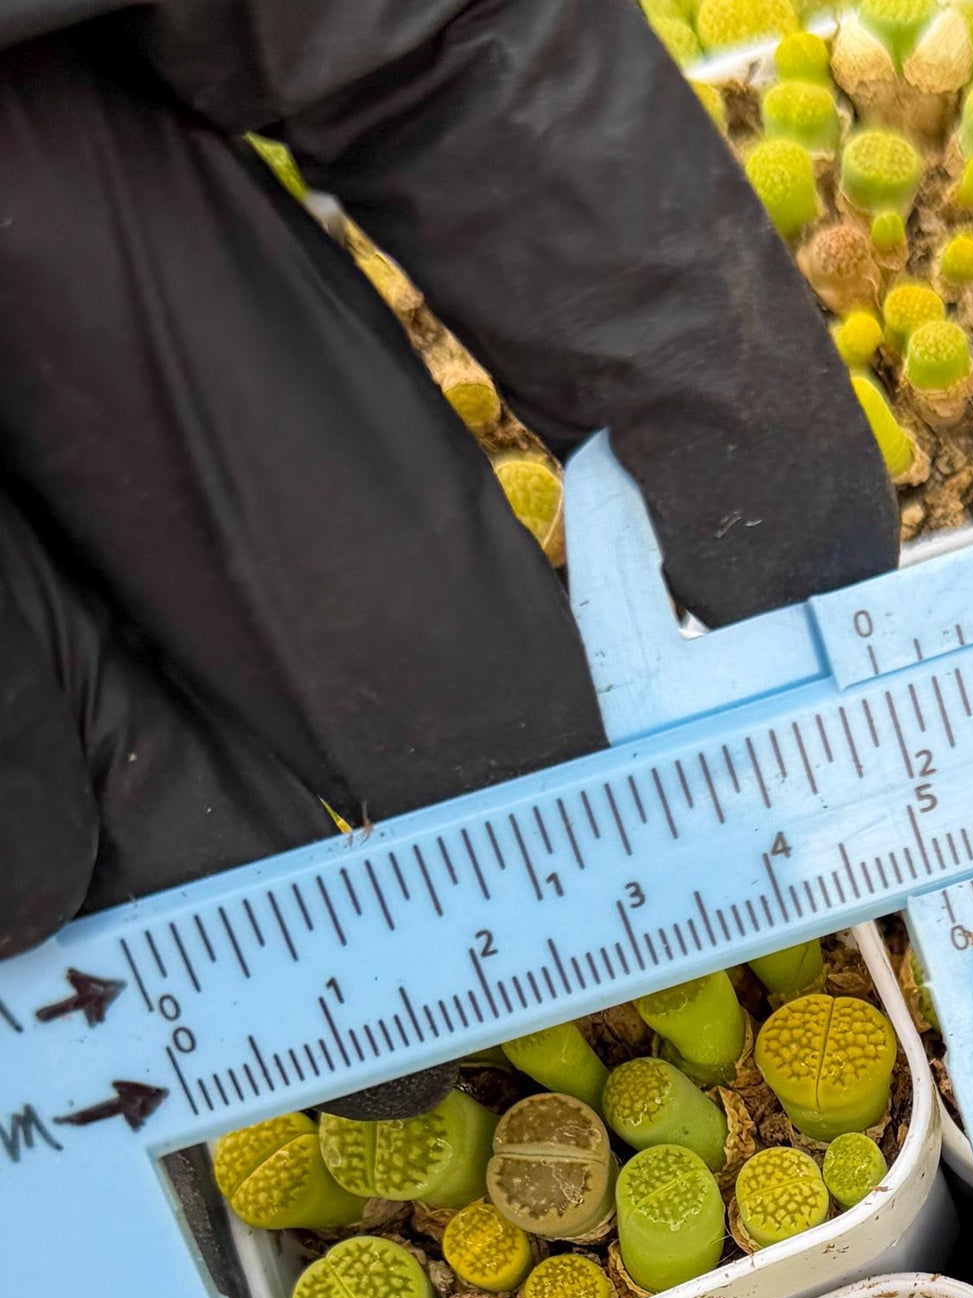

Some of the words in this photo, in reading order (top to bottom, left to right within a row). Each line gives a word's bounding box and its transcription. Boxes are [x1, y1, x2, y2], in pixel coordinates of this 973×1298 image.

[853, 610, 873, 637] 0
[159, 994, 181, 1021] 0
[545, 872, 564, 897] 1
[915, 749, 937, 777] 2
[173, 1026, 196, 1053] 0
[326, 977, 345, 1004] 1
[475, 929, 498, 957] 2
[624, 881, 646, 908] 3
[771, 831, 793, 858] 4
[914, 783, 938, 813] 5
